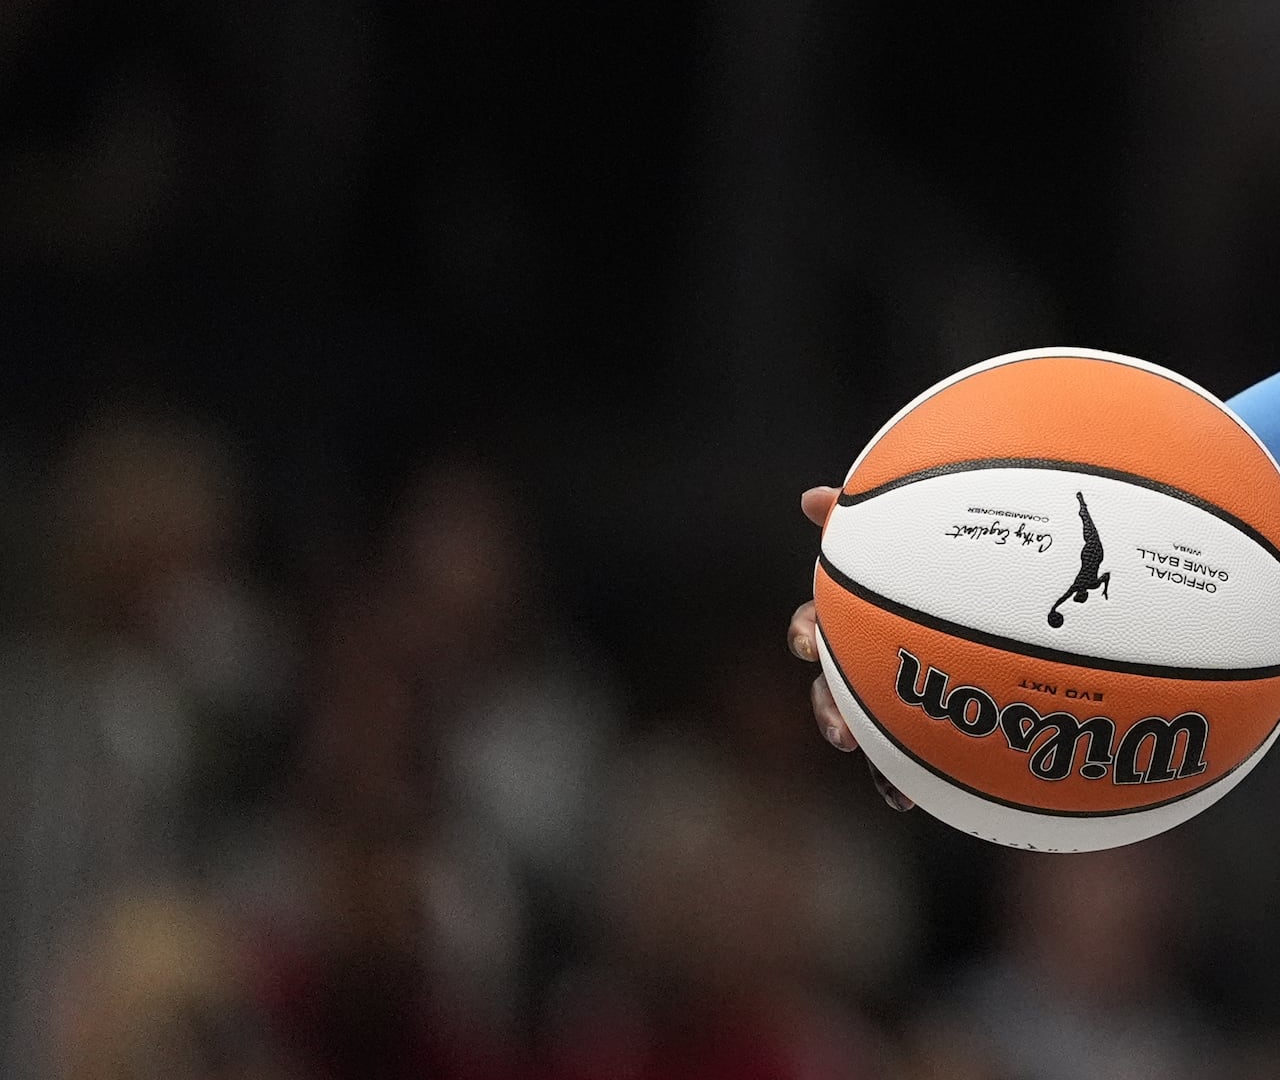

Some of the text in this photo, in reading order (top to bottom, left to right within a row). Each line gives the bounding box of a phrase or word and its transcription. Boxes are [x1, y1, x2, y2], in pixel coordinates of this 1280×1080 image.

[967, 506, 1050, 524] COMMISSIONER
[1172, 543, 1203, 557] WNBA
[1136, 547, 1230, 582] GAME BALL
[1145, 564, 1218, 594] OFFICIAL
[1017, 679, 1104, 702] EVO NXT
[895, 648, 1209, 785] Wilson
